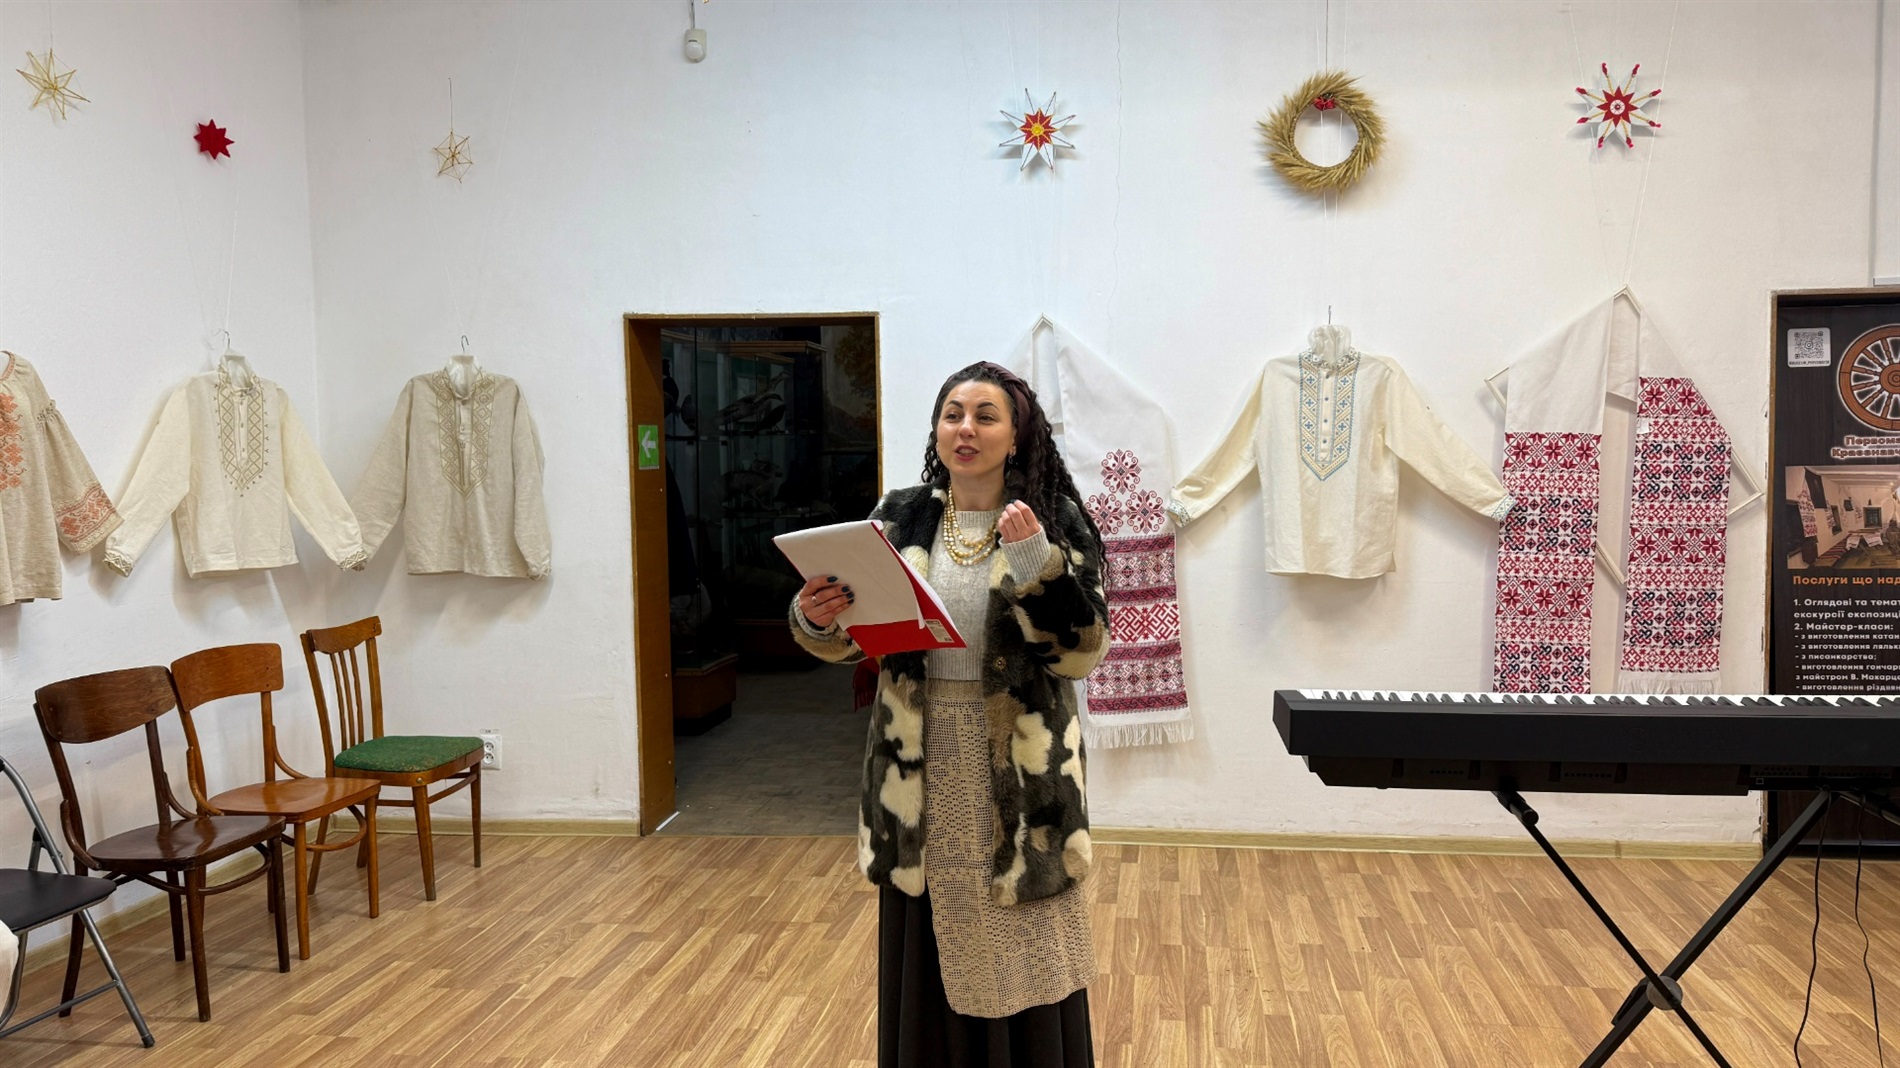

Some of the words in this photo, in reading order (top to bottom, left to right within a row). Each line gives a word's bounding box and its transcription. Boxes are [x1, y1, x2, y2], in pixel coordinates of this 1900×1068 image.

[1793, 575, 1848, 586] Послуги
[1852, 576, 1873, 585] що
[1877, 576, 1900, 585] над
[1793, 598, 1801, 606] 1.
[1804, 598, 1852, 607] Оглядові
[1793, 611, 1845, 619] екскурсії
[1806, 622, 1894, 631] Майстер-класи:
[1802, 673, 1848, 681] майстром
